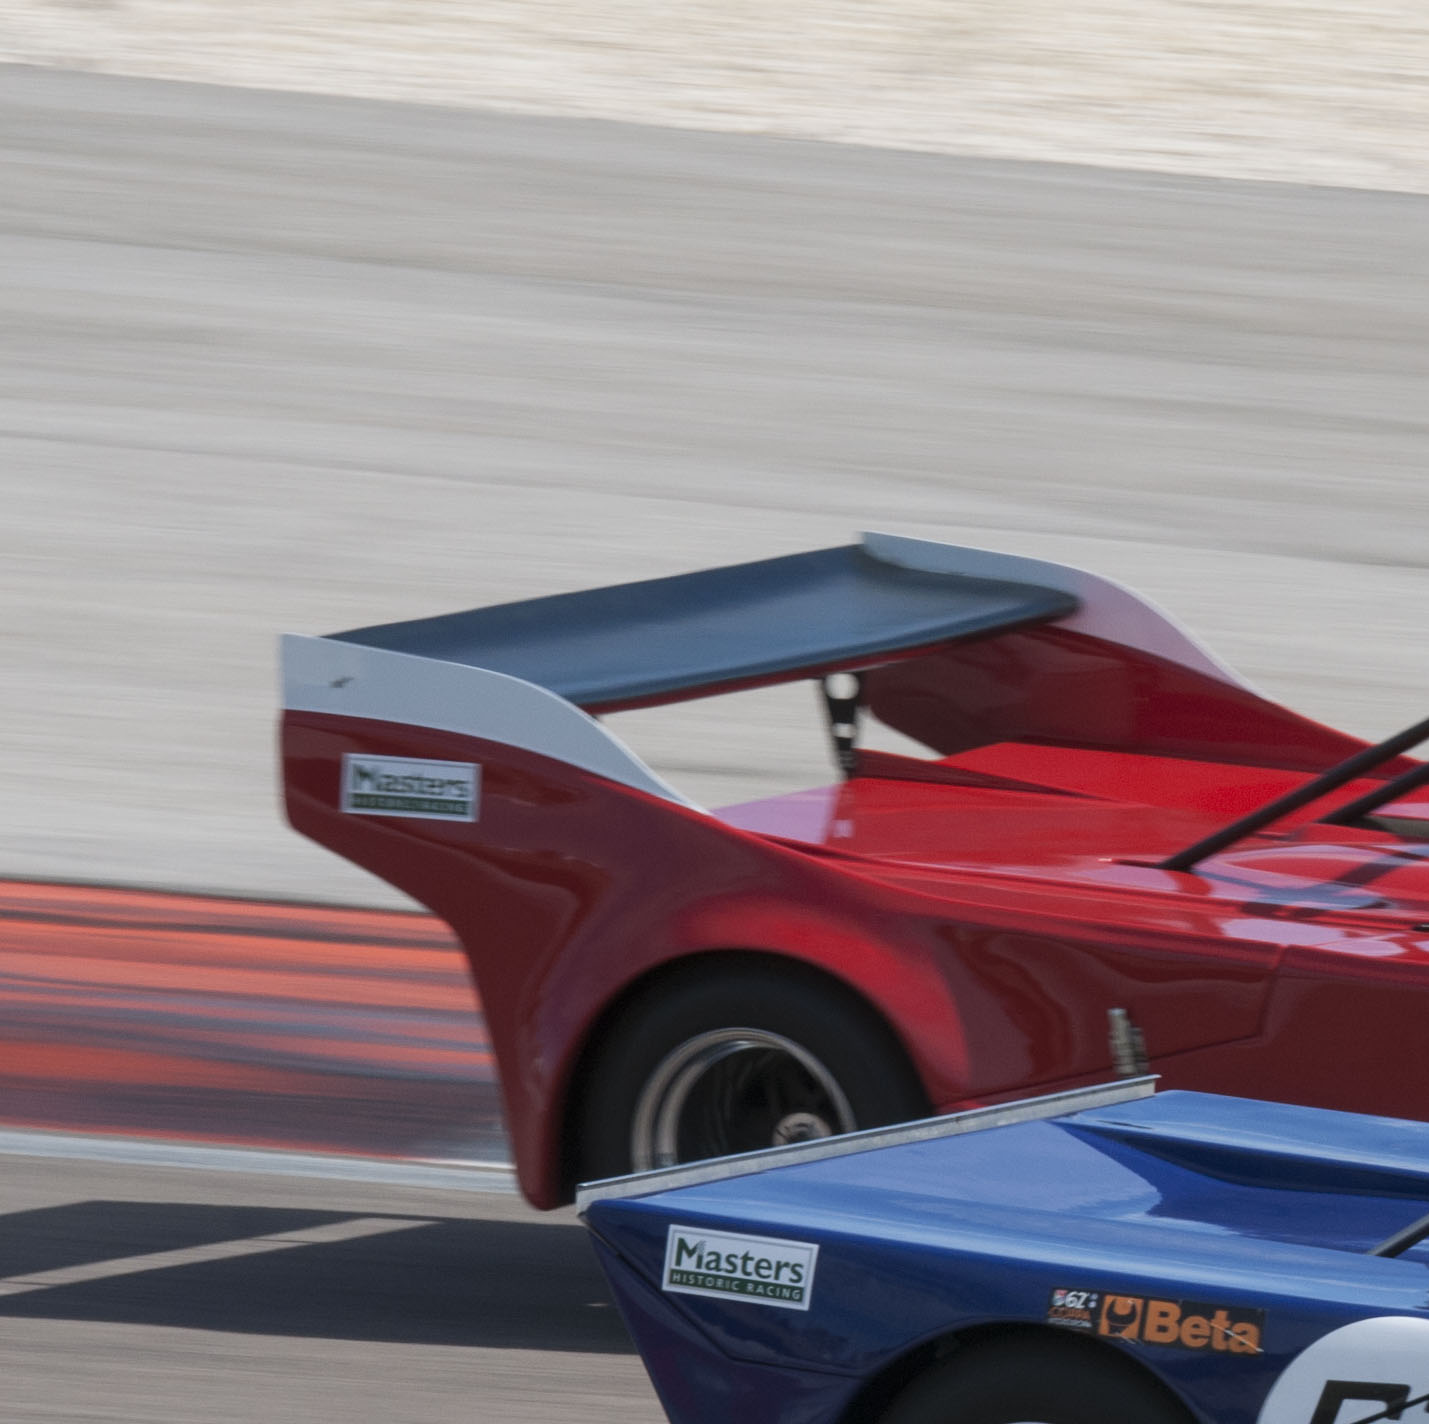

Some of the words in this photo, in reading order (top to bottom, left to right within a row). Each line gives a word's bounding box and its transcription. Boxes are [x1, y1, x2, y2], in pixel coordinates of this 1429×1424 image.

[352, 763, 469, 799] Masters
[675, 1237, 805, 1284] Masters
[672, 1272, 740, 1291] HISTORIC
[746, 1282, 801, 1300] RACING
[1144, 1300, 1260, 1354] Beta
